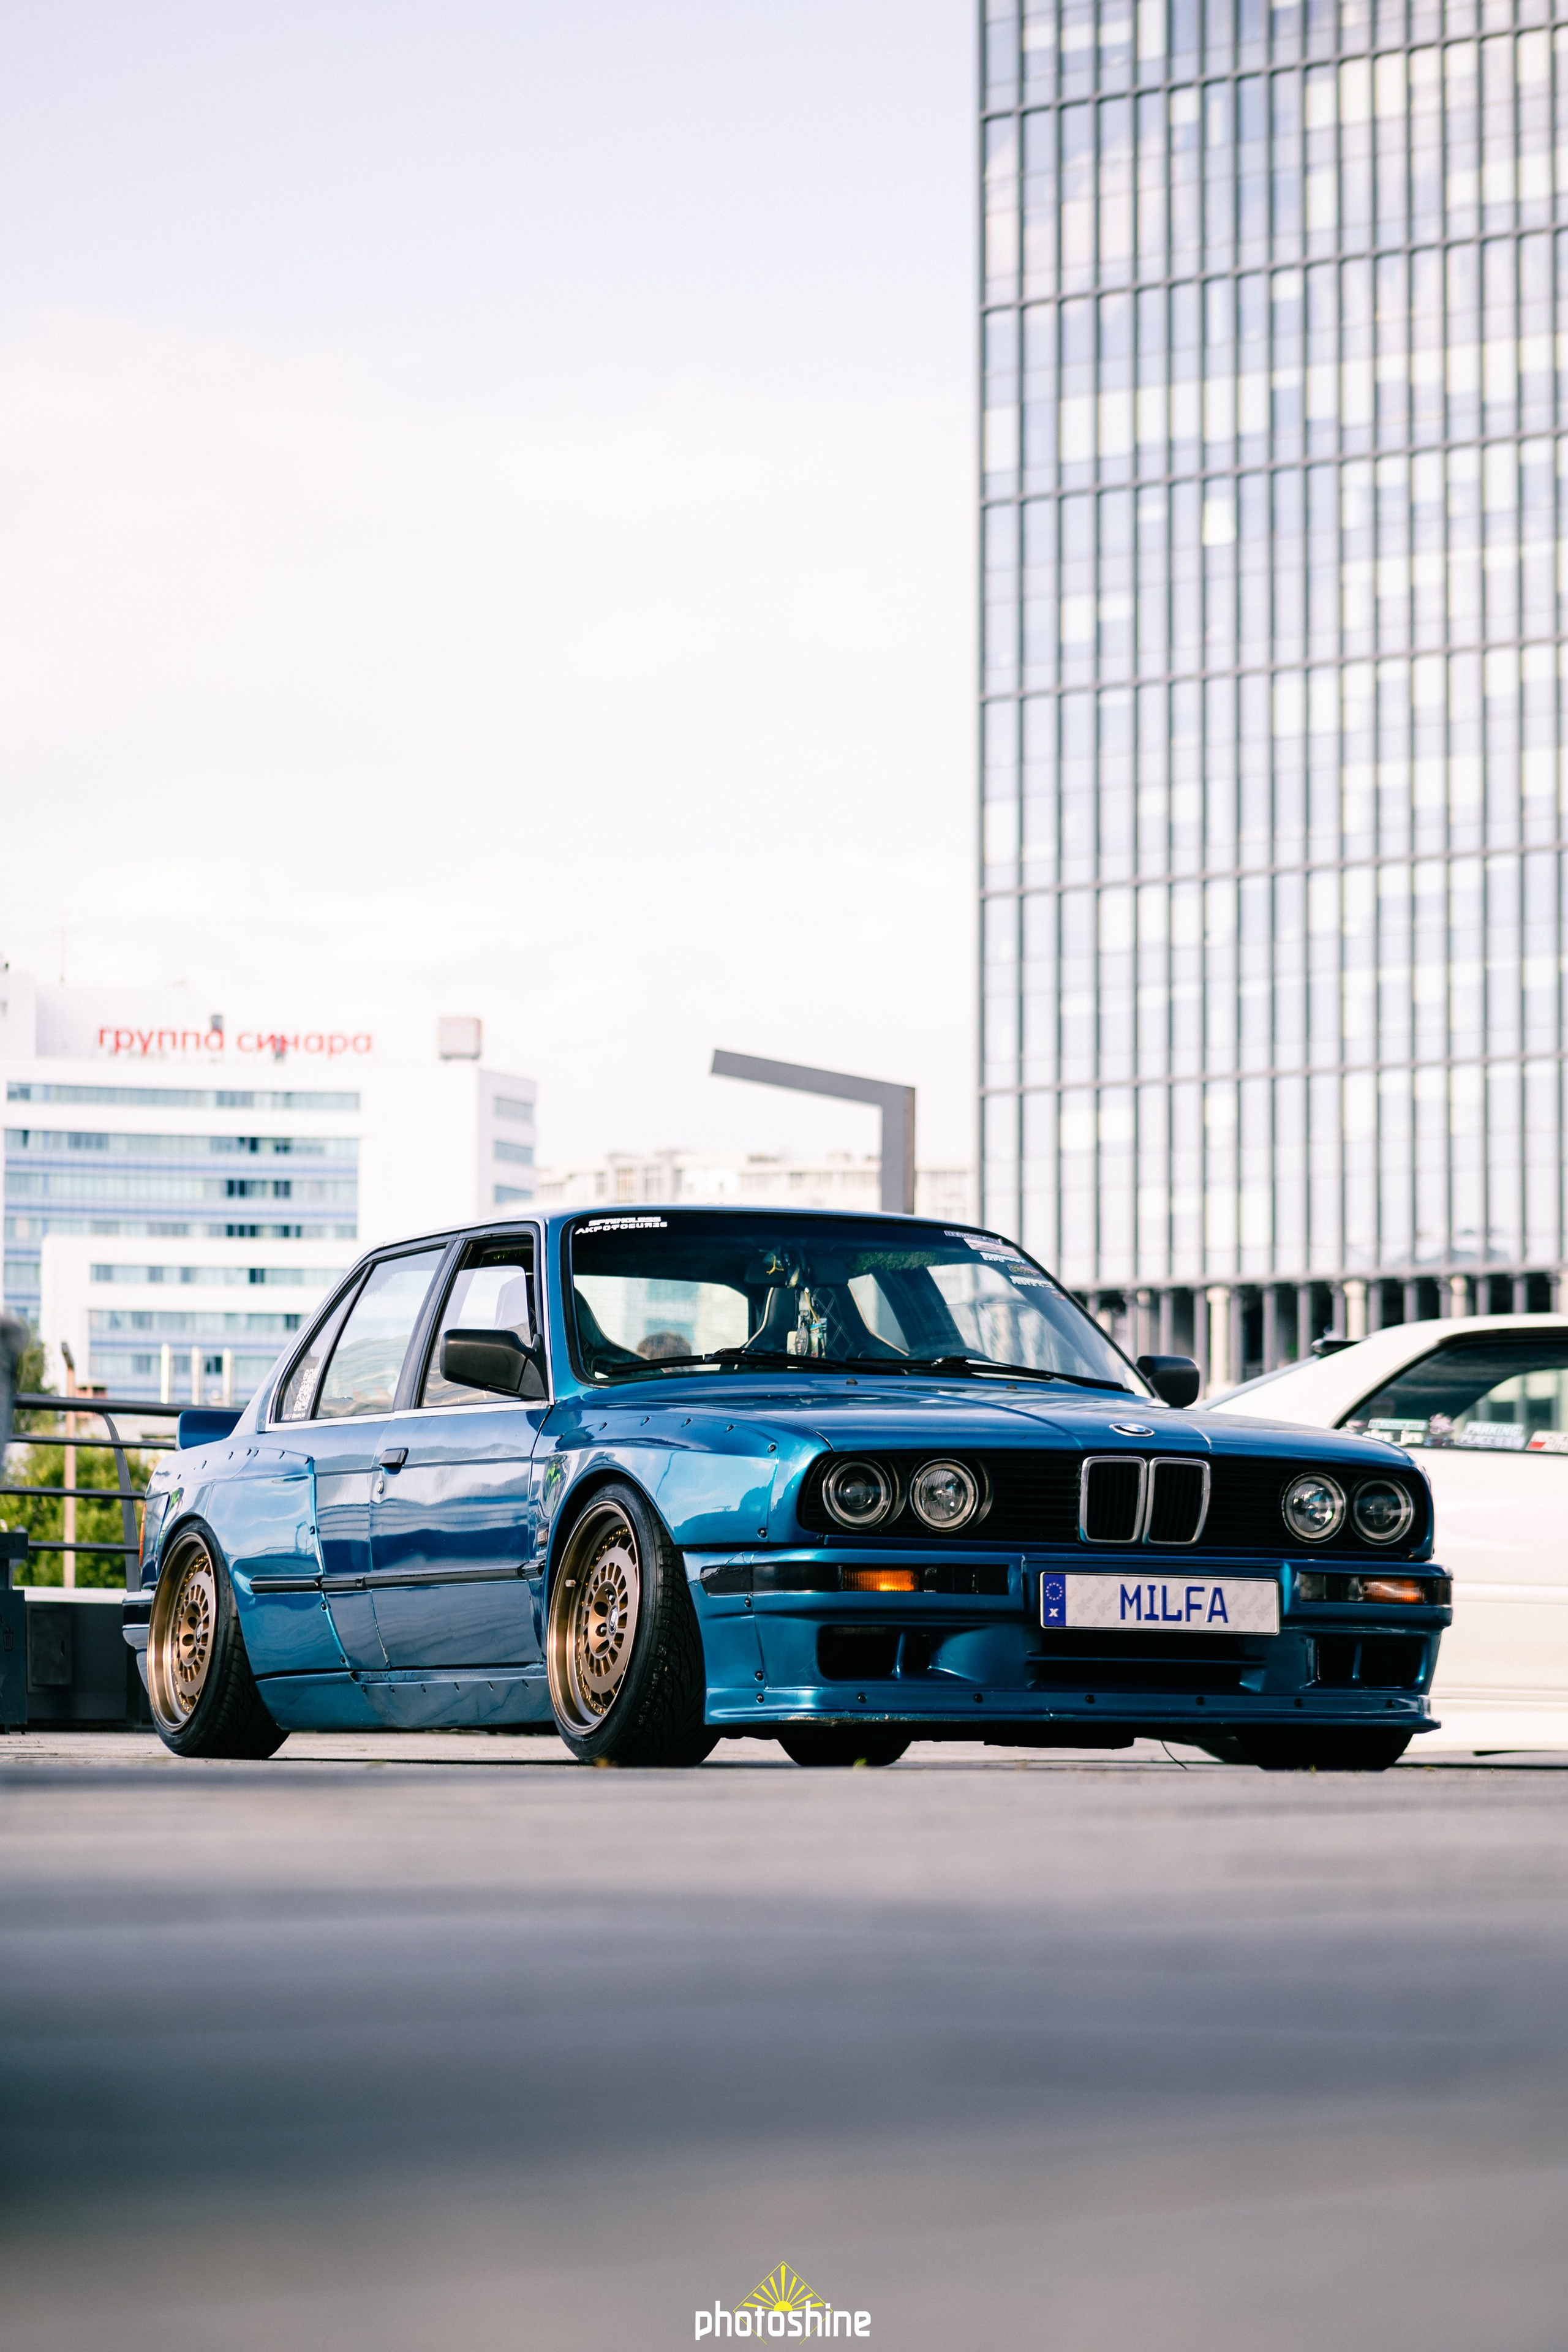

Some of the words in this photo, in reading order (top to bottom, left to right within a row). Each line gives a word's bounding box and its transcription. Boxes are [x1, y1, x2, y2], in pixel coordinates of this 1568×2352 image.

[99, 1027, 224, 1057] группа
[236, 1030, 372, 1059] синара
[1119, 1583, 1229, 1624] MILFA
